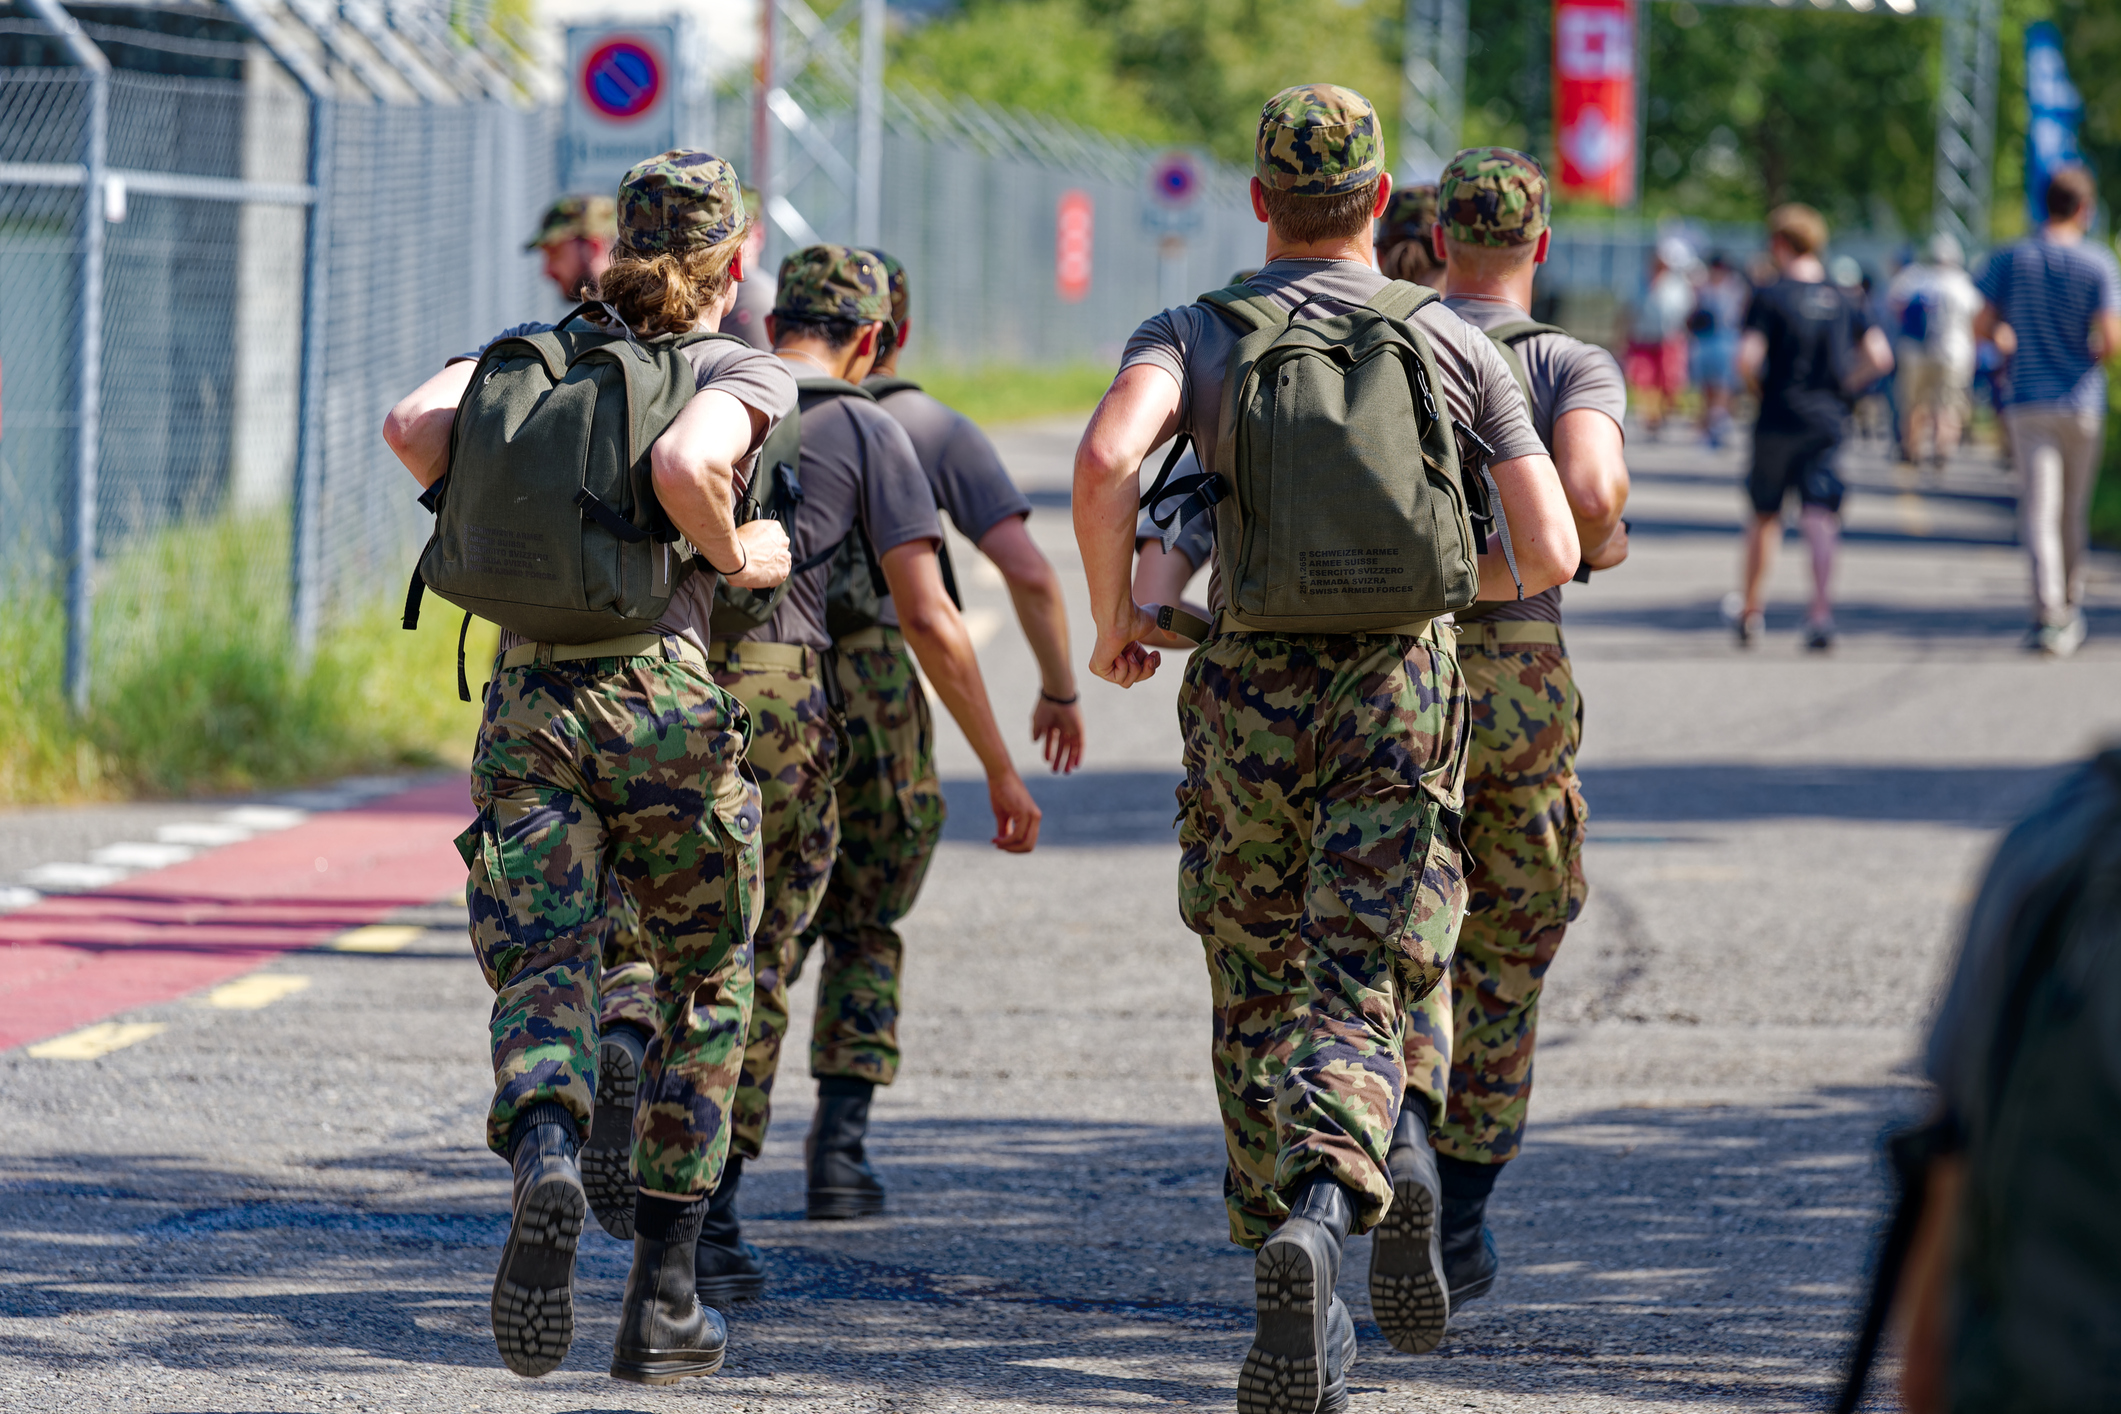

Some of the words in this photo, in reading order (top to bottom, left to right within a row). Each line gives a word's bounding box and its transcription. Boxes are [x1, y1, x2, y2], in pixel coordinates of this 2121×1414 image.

[1308, 549, 1363, 558] SCHWEIZER
[1366, 548, 1399, 556] ARMEE
[1308, 559, 1342, 567] ARMEE
[1344, 558, 1378, 566] SUISSE
[1299, 551, 1307, 594] 2511.2658
[1309, 568, 1355, 577] ESERCITO
[1357, 567, 1404, 575] SVIZZERO
[1310, 578, 1349, 586] ARMADA
[1352, 577, 1386, 585] SVIZRA
[1309, 587, 1338, 595] SWISS
[1376, 585, 1413, 593] FORCES
